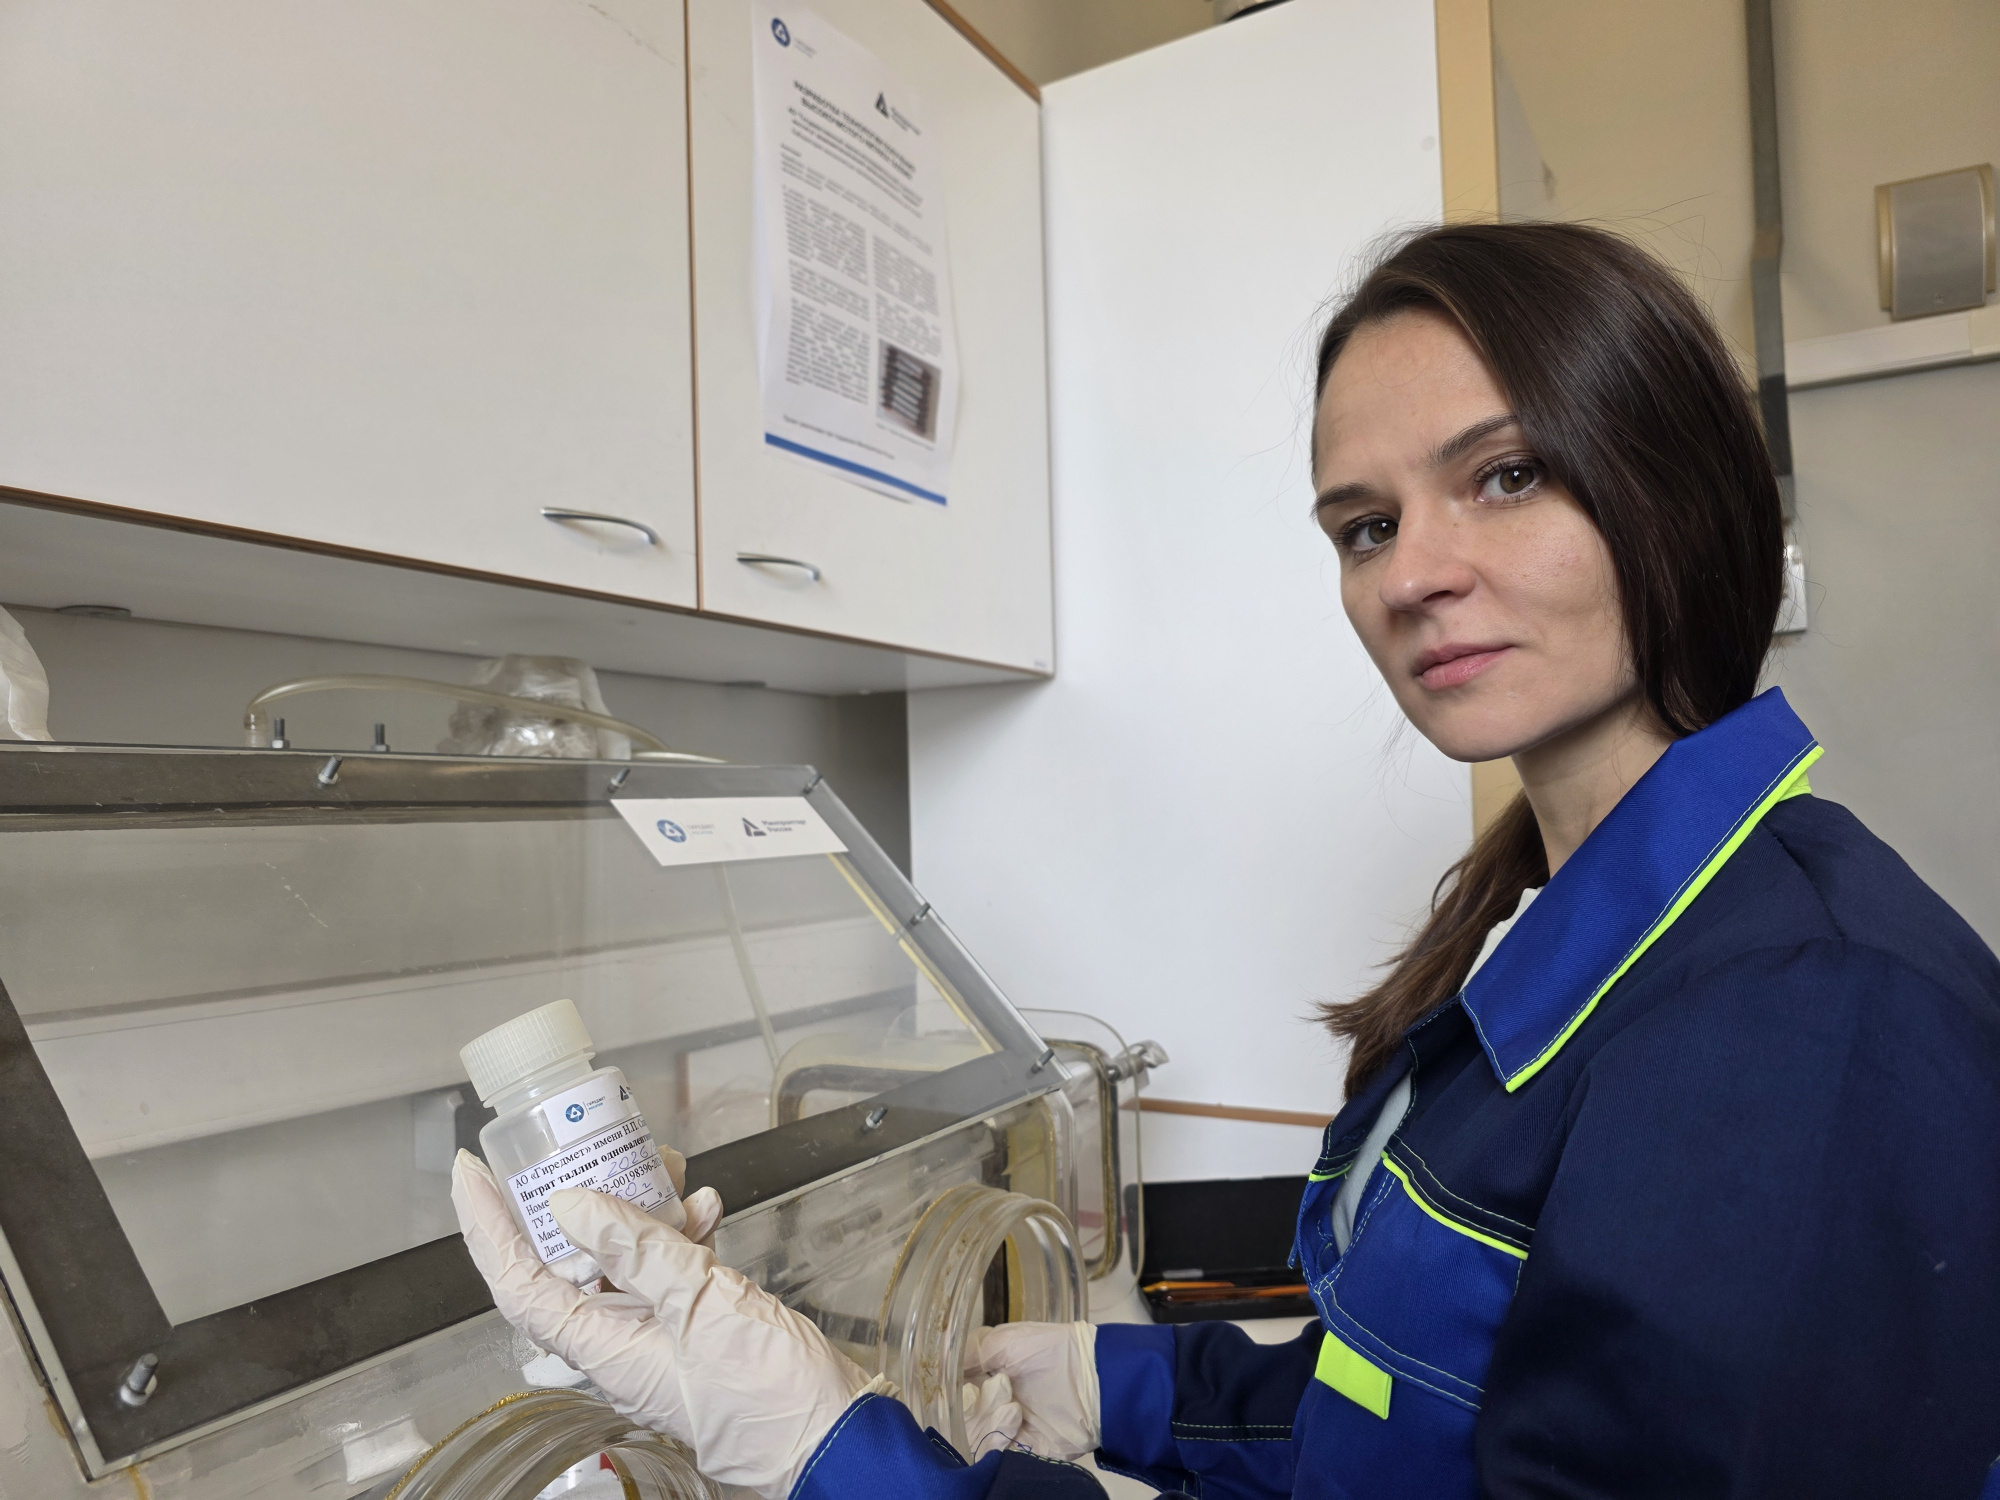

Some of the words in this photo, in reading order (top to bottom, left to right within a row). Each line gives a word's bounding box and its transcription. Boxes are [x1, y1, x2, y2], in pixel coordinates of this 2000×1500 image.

[516, 1174, 529, 1189] АО
[531, 1146, 591, 1180] «Гиредмет»
[593, 1131, 623, 1150] имени
[520, 1179, 556, 1202] Нитрат
[558, 1158, 599, 1184] таллия
[526, 1199, 550, 1216] Номе
[532, 1215, 545, 1229] ТУ
[538, 1227, 560, 1243] Масс
[544, 1241, 565, 1258] Дата
